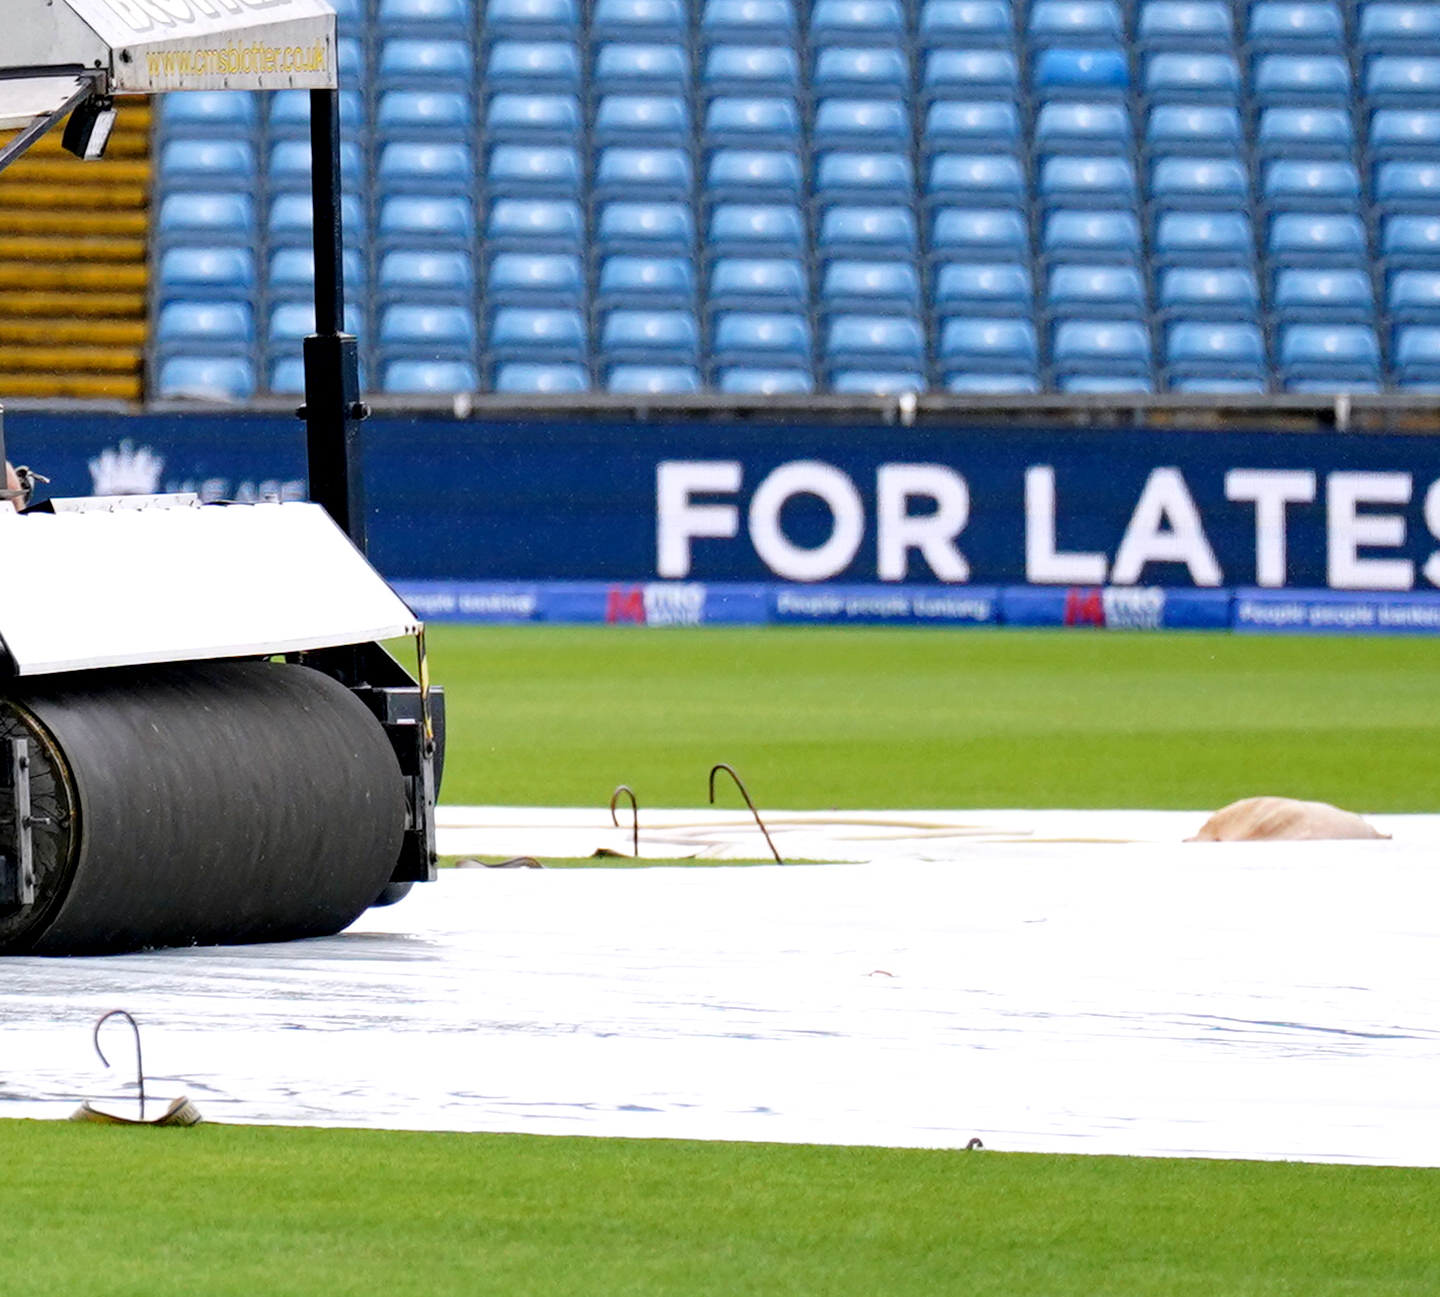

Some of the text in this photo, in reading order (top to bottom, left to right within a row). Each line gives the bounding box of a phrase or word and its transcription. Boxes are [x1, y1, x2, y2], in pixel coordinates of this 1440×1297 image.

[145, 38, 327, 77] www.cmsblotter.co.uk
[655, 458, 1440, 593] FOR LATE
